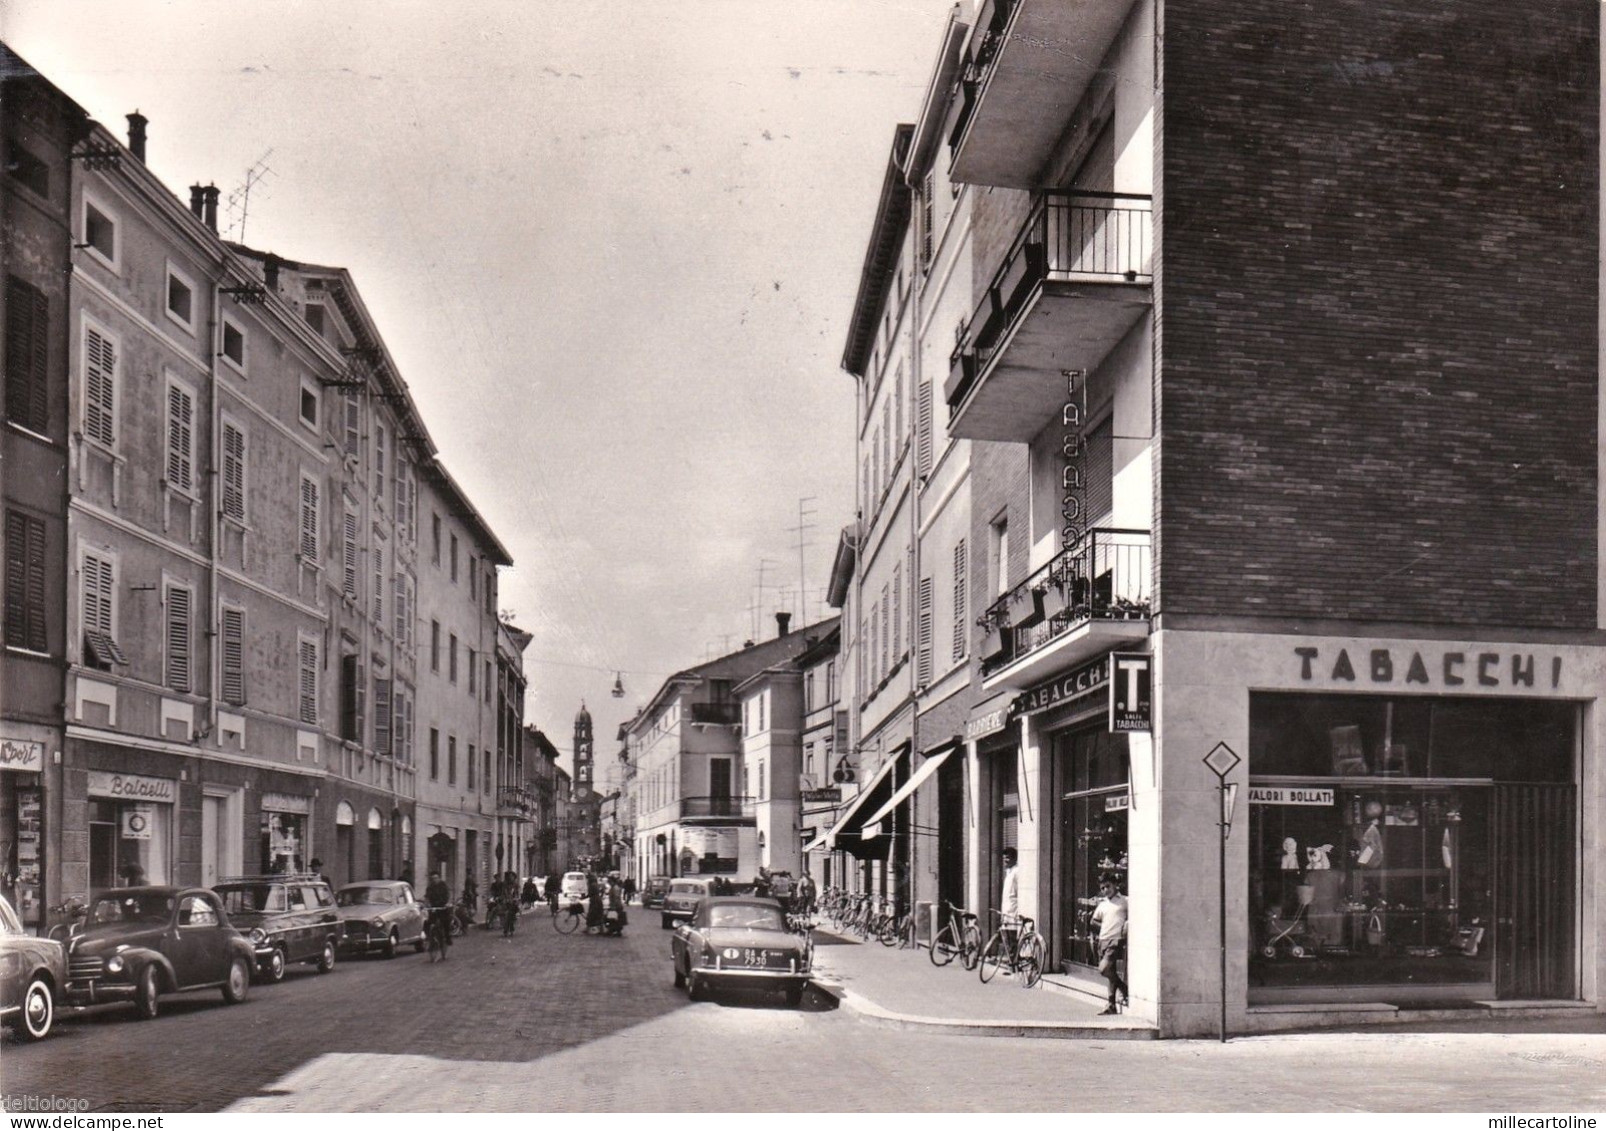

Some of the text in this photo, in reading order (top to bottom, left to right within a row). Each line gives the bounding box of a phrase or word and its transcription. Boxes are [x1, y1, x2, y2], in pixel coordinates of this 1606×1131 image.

[1294, 647, 1562, 688] TABACCHI
[1118, 660, 1148, 712] T
[1116, 719, 1150, 729] TABACCHI
[110, 775, 171, 798] Baldelli
